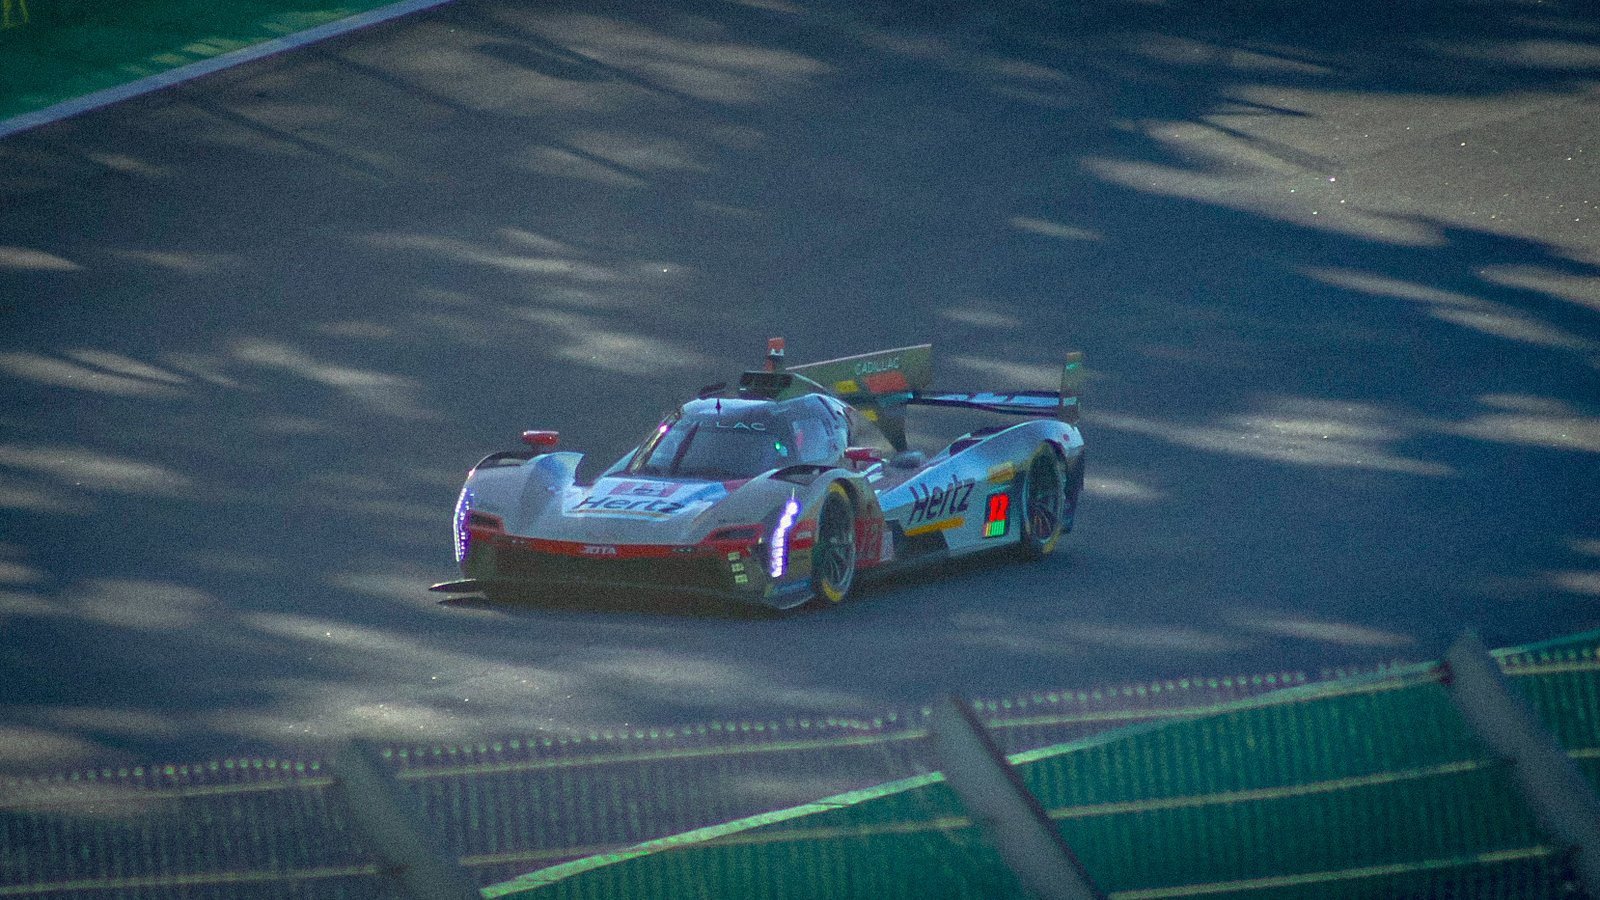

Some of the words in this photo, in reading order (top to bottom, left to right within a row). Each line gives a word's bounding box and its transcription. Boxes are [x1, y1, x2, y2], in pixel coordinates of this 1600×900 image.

[855, 357, 899, 375] CADILLAC
[572, 497, 685, 513] Hertz
[908, 474, 975, 524] Hertz
[583, 545, 616, 555] JOTA
